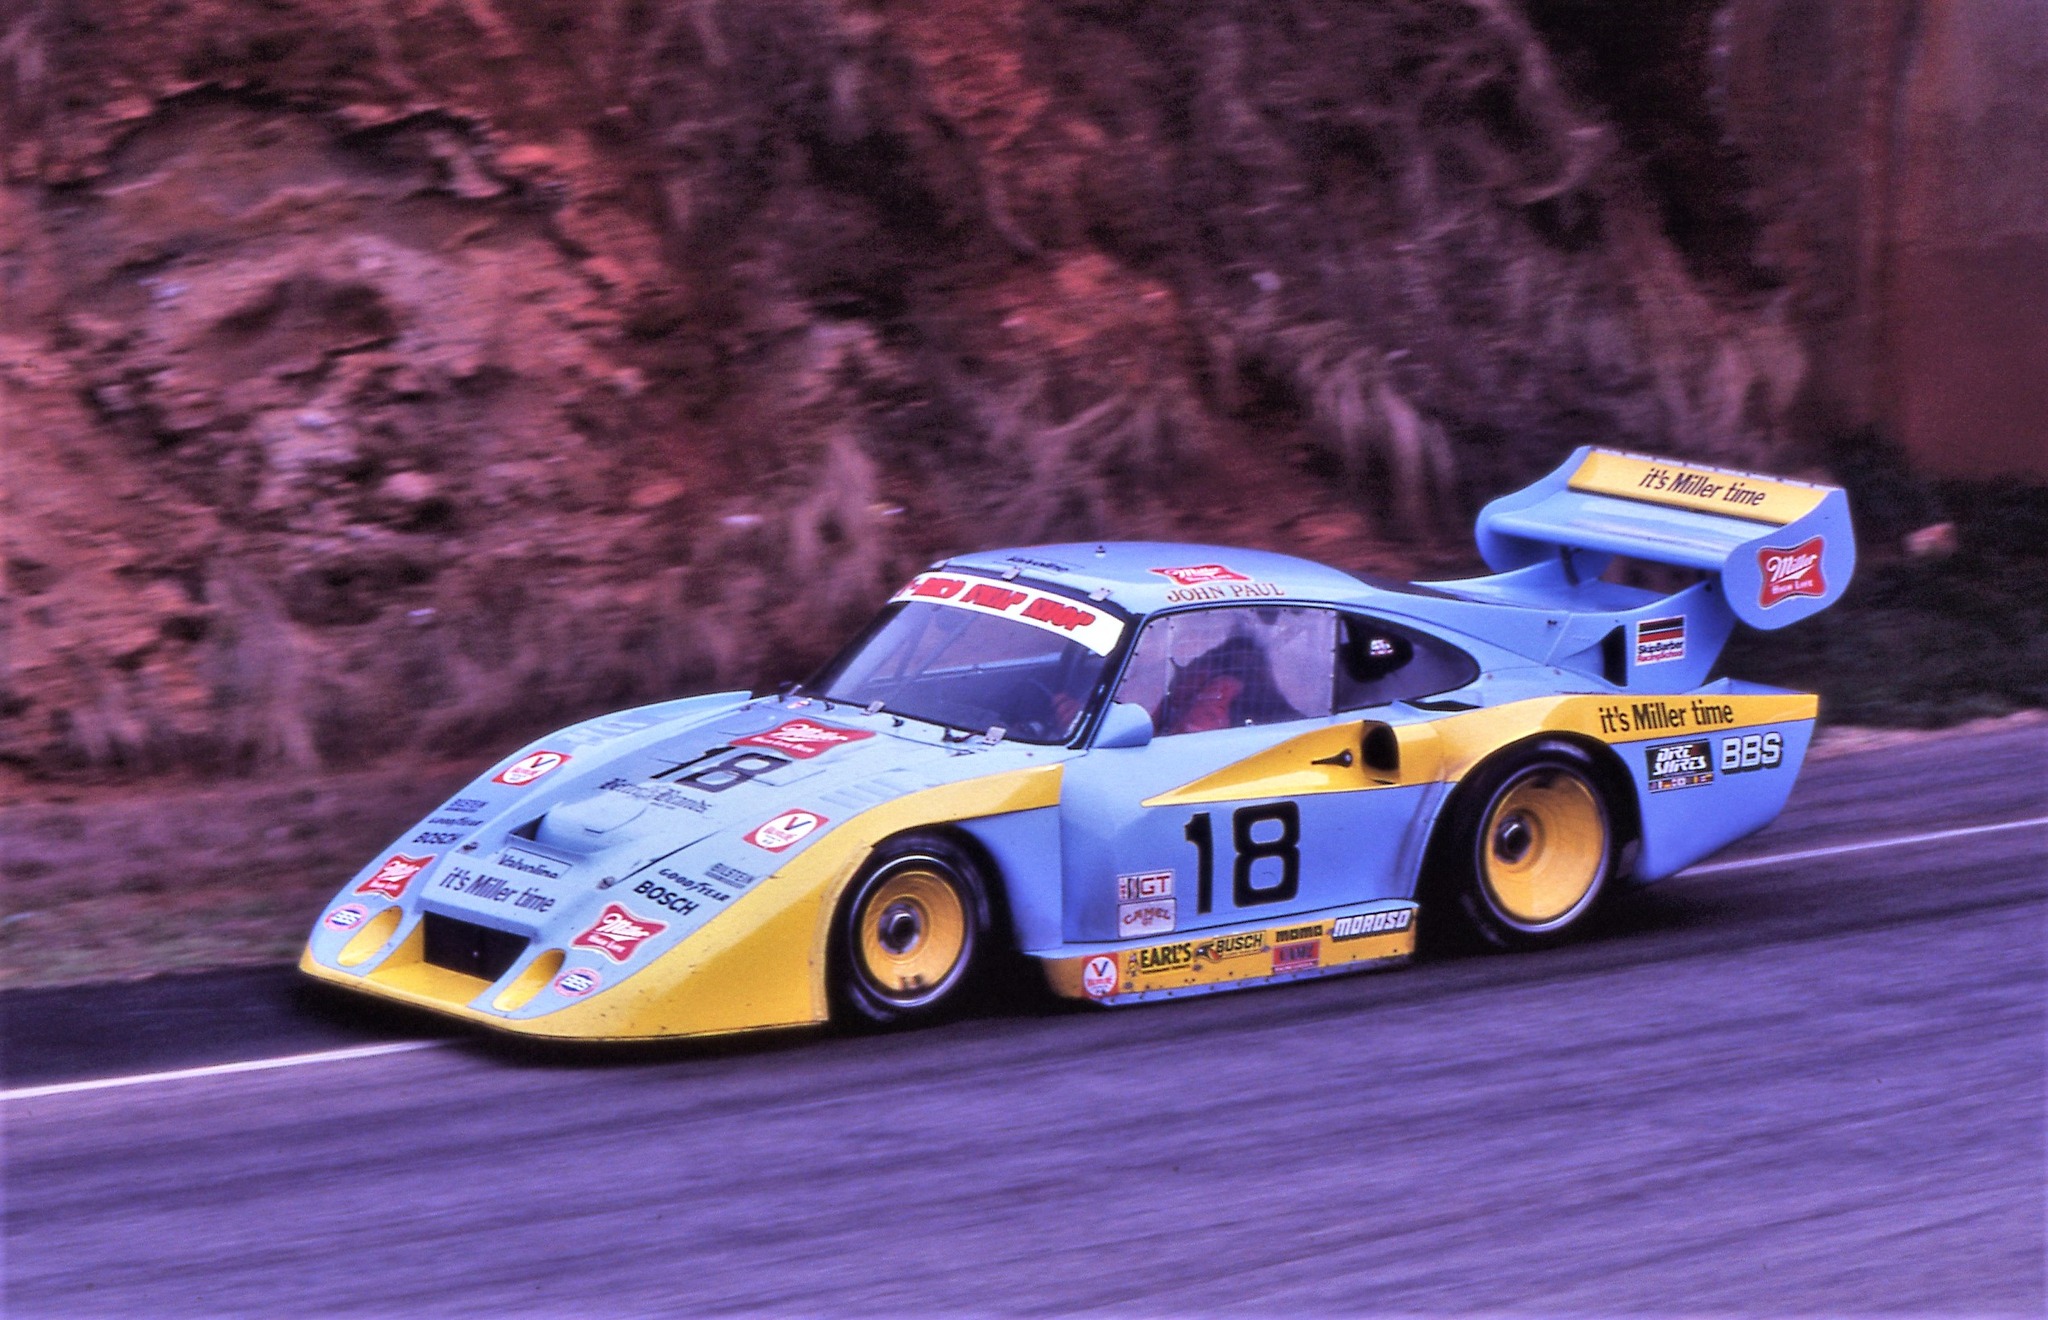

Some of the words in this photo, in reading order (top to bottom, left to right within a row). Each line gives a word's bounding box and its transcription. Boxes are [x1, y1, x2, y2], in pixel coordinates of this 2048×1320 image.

[1638, 467, 1670, 489] it's
[1666, 472, 1724, 498] Miller
[1722, 482, 1766, 506] time
[1766, 554, 1818, 582] Miller
[1167, 585, 1225, 602] JOHN
[1229, 583, 1285, 598] PAUL
[1598, 706, 1630, 734] it's
[1631, 702, 1686, 731] Miller
[1691, 698, 1734, 725] time
[1721, 731, 1783, 772] BBS
[649, 746, 793, 793] 18
[1184, 800, 1300, 914] 18
[439, 866, 471, 891] it's
[464, 873, 518, 902] Miller
[513, 887, 556, 912] time
[633, 880, 699, 916] BOSCH
[1141, 875, 1170, 895] GT
[1123, 907, 1171, 925] CAMEL
[1333, 910, 1411, 937] MOROSO
[1140, 943, 1192, 968] EARL'S
[1216, 933, 1262, 953] BUSCH
